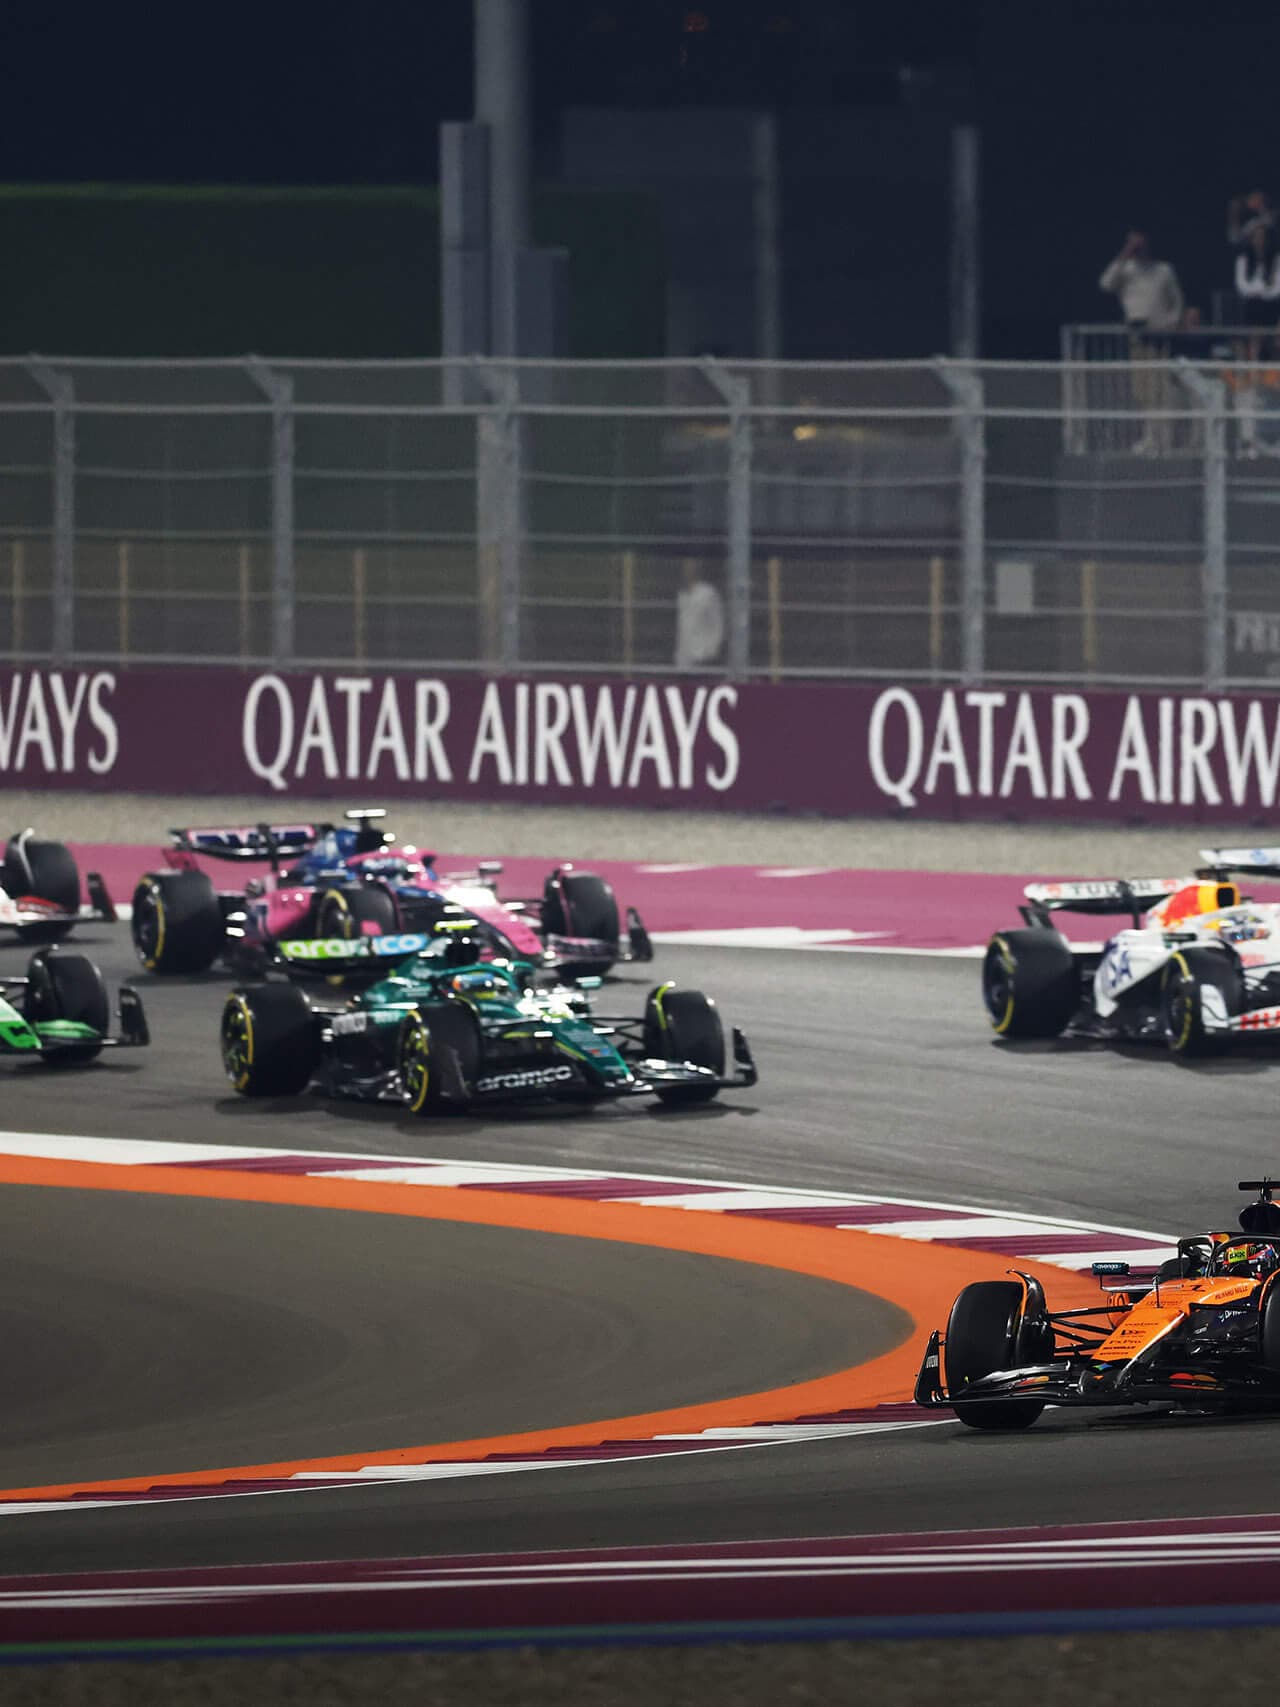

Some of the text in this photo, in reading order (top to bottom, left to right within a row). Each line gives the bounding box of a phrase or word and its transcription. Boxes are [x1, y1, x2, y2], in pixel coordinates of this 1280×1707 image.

[242, 673, 740, 792] QATAR AIRWAYS
[867, 686, 1093, 808] QATAR
[477, 1065, 573, 1092] aramco
